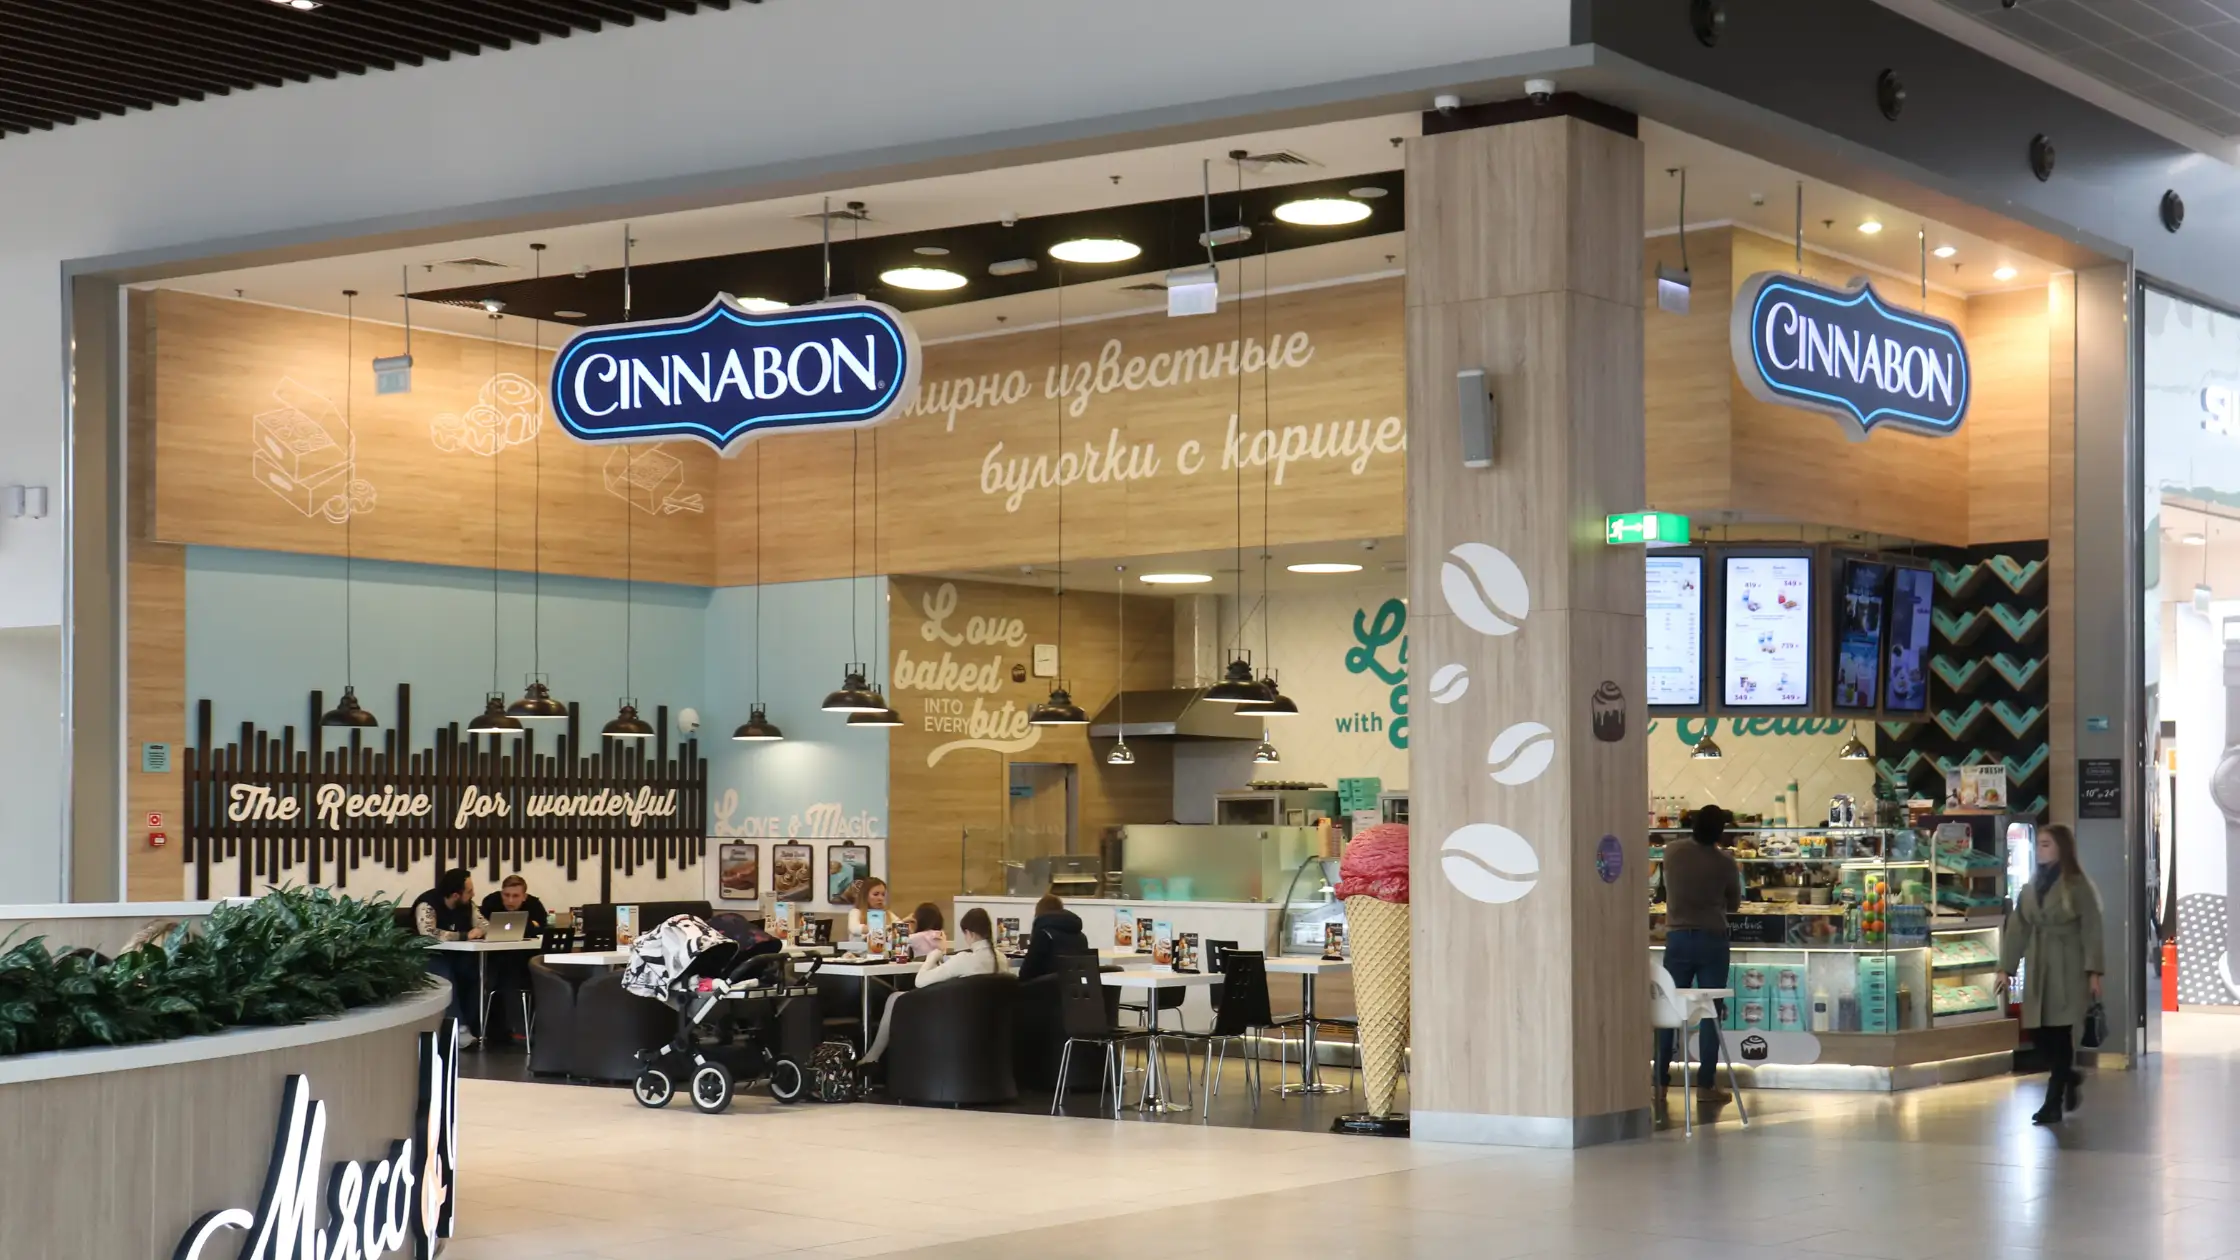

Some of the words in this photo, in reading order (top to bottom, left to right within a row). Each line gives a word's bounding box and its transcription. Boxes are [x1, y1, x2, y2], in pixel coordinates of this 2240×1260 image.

[574, 334, 877, 417] CINNABON
[1045, 330, 1315, 417] известные
[1765, 301, 1953, 407] CINNABON
[979, 426, 1161, 512] булочки
[1175, 445, 1206, 476] с
[1222, 414, 1407, 486] корице
[921, 582, 1028, 647] Love
[894, 650, 1003, 693] baked
[924, 697, 963, 714] INTO
[924, 716, 970, 735] EVERY
[968, 697, 1031, 739] bite
[1335, 711, 1383, 733] with
[228, 783, 300, 821] The
[316, 782, 431, 831] Recipe
[455, 784, 511, 830] for
[526, 785, 677, 828] wonderful
